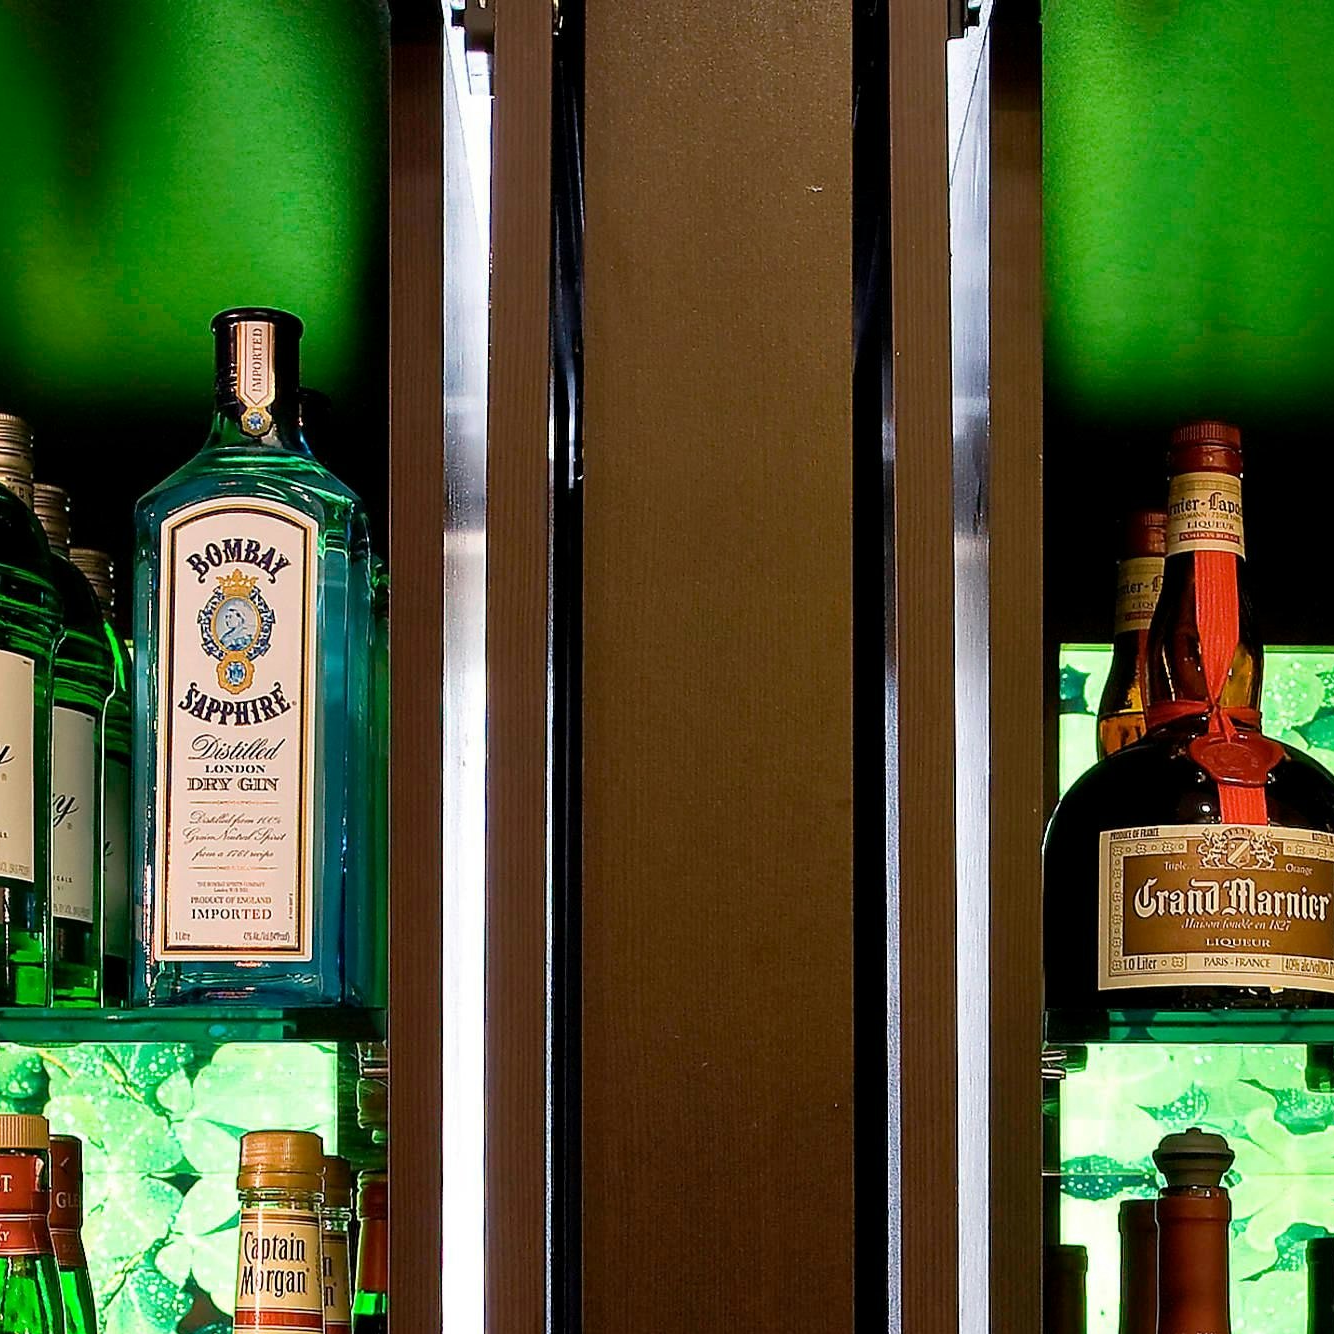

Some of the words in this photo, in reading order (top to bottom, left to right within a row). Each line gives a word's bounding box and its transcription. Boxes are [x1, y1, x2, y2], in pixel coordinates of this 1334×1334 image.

[252, 327, 262, 393] IMPORTED
[1187, 520, 1235, 531] LIQUEUR
[187, 538, 292, 584] BOMBAY
[178, 682, 292, 727] SAPPHIRE
[188, 734, 286, 761] Distilled
[205, 765, 266, 773] LONDON
[187, 777, 232, 791] DRY
[238, 777, 280, 791] GIN
[1285, 863, 1313, 875] Orange
[191, 896, 224, 904] PRODUCT
[236, 896, 271, 904] ENGLAND
[1134, 877, 1220, 919] Grand
[1221, 877, 1329, 921] Marnier
[192, 909, 272, 920] IMPORTED
[1182, 918, 1220, 930] Maison
[1269, 919, 1292, 931] 1827
[1206, 938, 1271, 948] LIQUEUR
[1204, 957, 1229, 967] PARIS
[1236, 957, 1271, 968] FRANCE
[244, 1230, 306, 1262] Captain
[240, 1267, 306, 1298] Morgan
